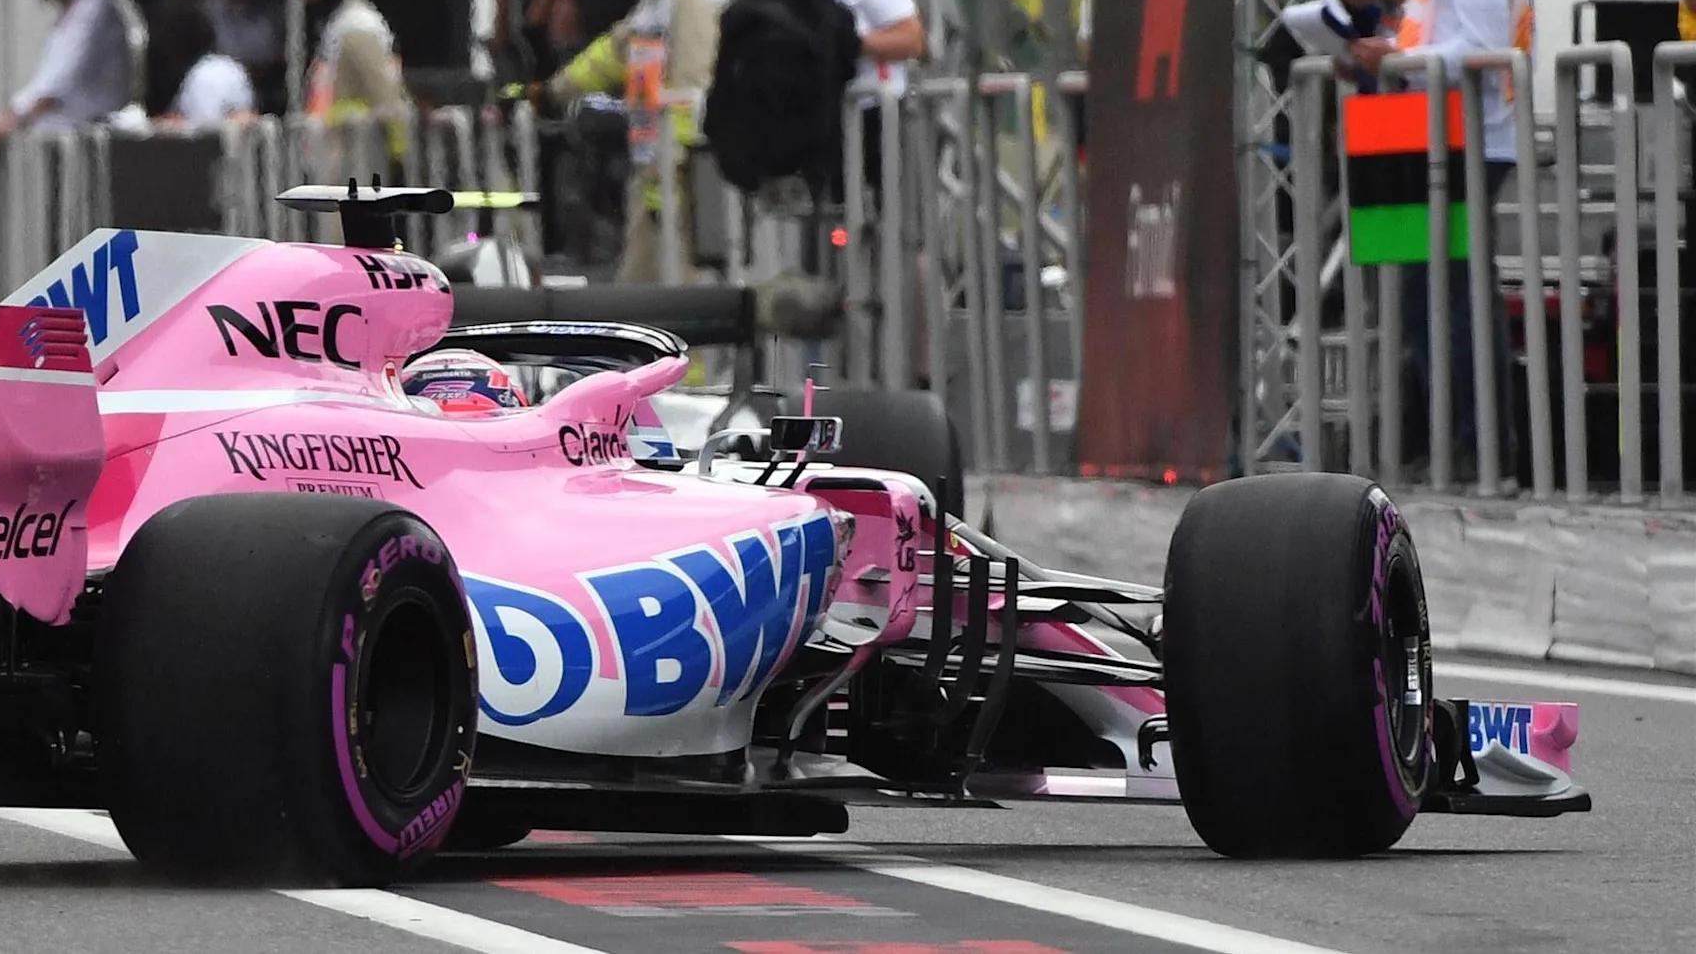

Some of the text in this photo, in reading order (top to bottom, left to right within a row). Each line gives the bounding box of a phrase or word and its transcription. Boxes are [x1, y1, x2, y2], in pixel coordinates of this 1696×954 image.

[24, 229, 140, 346] WT
[205, 300, 362, 371] NEC
[214, 431, 426, 490] KINGFISHER
[559, 420, 624, 467] Claro
[587, 515, 837, 718] BWT
[1468, 705, 1531, 755] BWT
